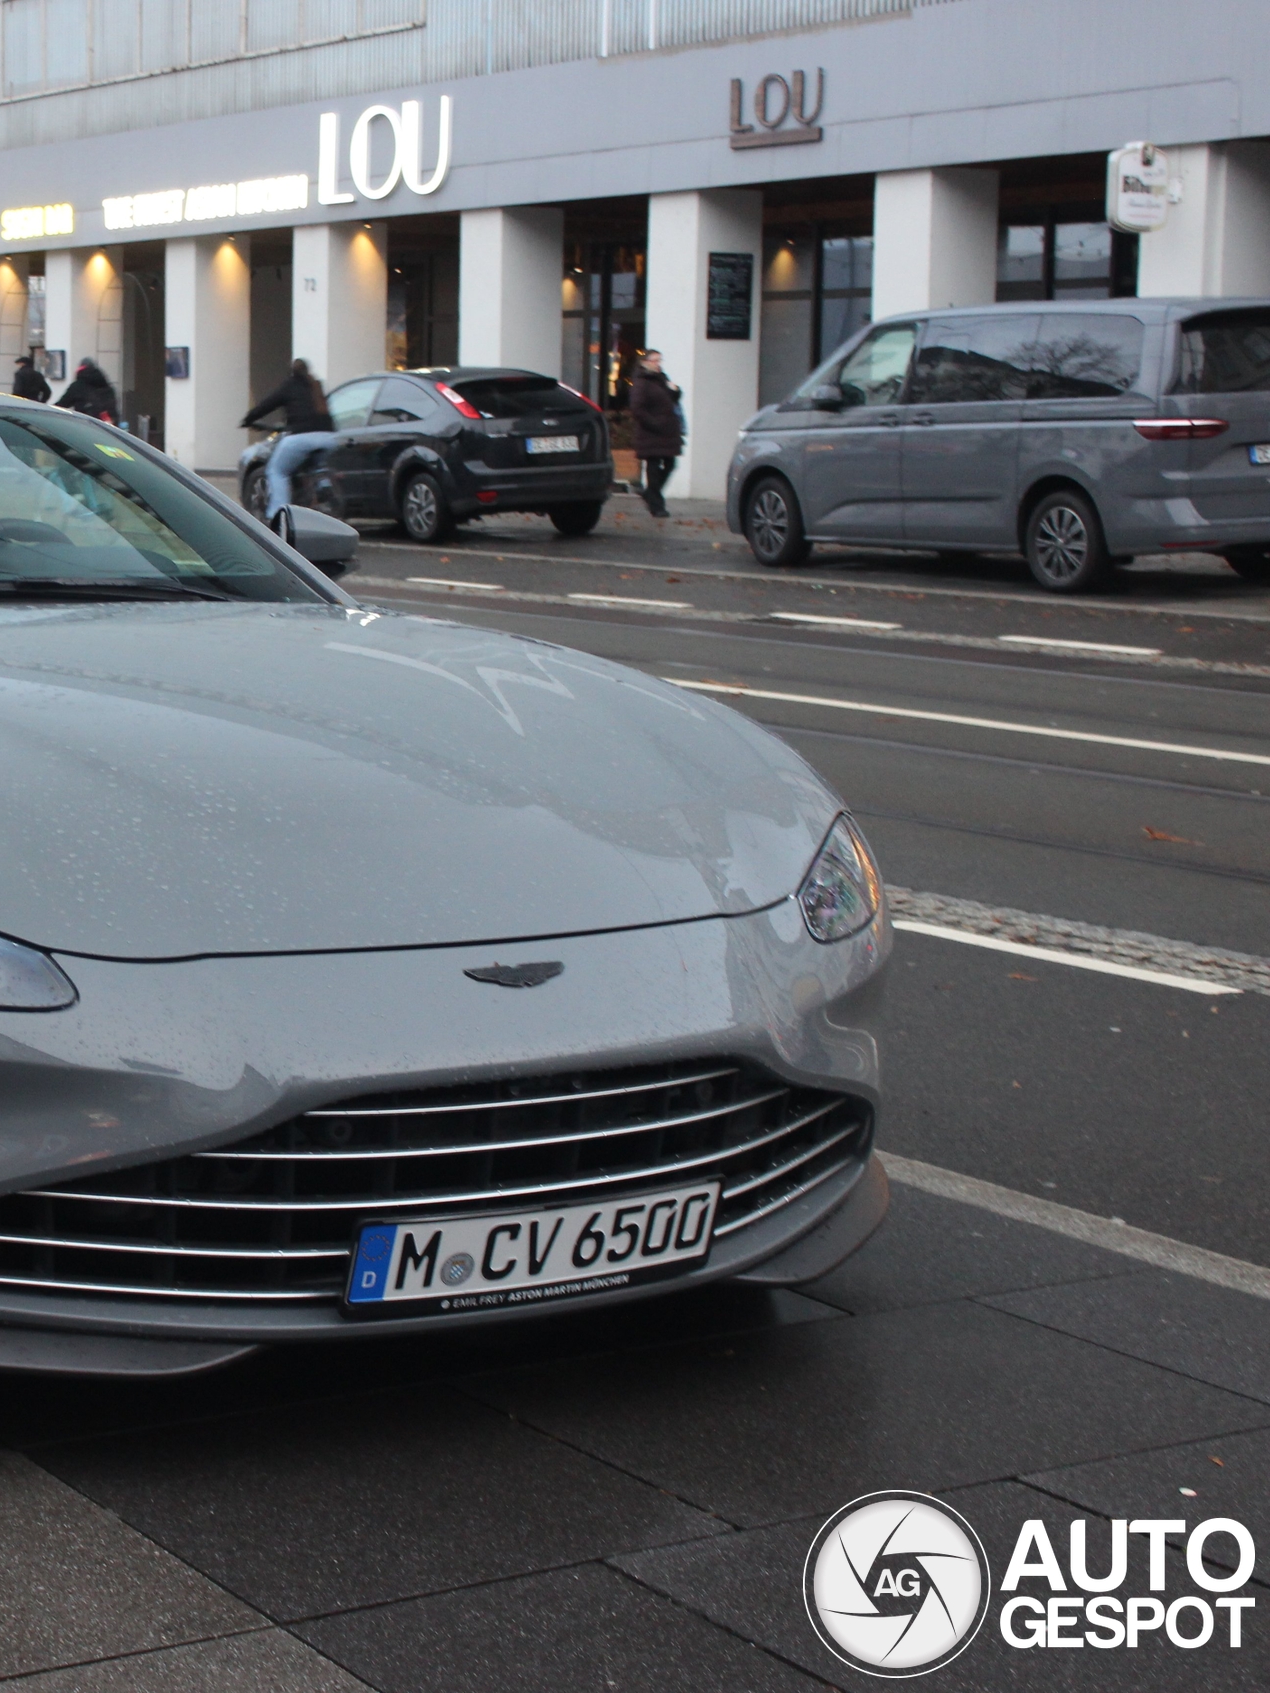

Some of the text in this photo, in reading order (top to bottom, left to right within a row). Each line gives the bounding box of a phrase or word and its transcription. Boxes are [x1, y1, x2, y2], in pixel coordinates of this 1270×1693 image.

[729, 67, 825, 133] LOU
[318, 94, 452, 207] LOU
[361, 1192, 711, 1291] D M CV 6500
[452, 1274, 630, 1309] EMIL FREY ASTON MARTIN MÜNCHEN
